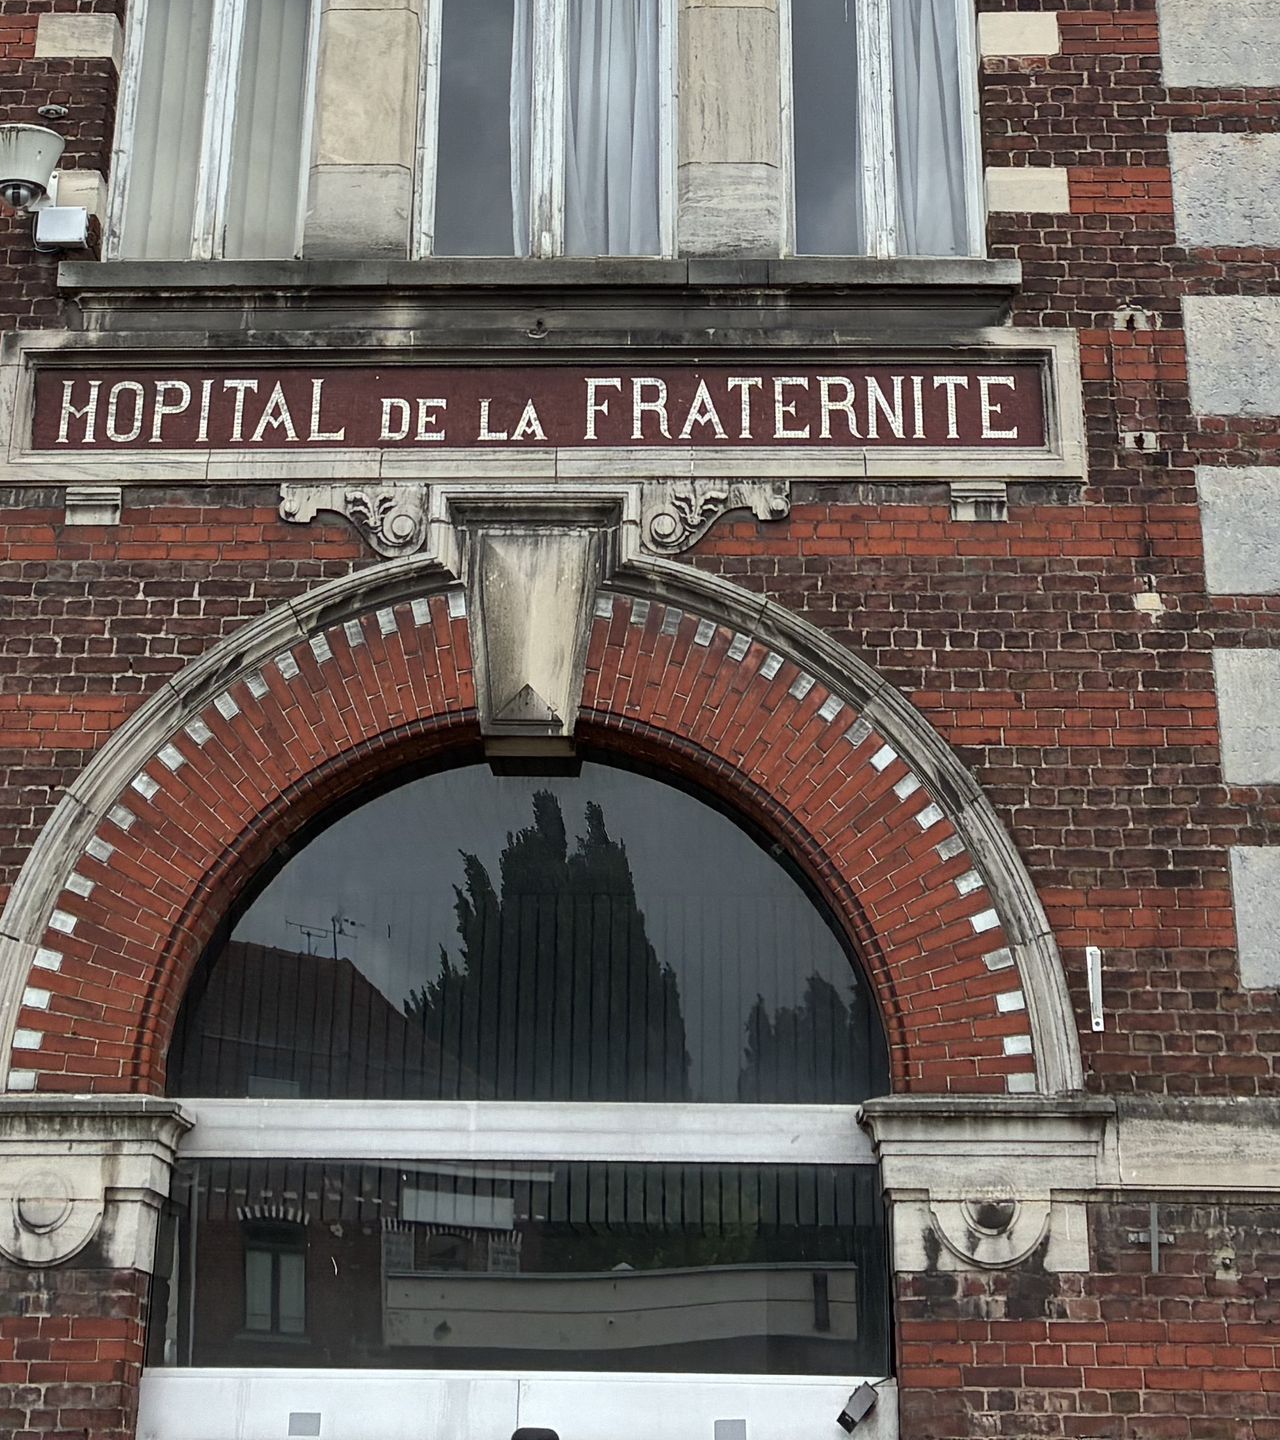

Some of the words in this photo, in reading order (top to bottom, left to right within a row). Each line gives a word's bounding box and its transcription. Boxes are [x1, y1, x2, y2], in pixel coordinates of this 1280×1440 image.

[55, 378, 345, 444] HOPITAL
[377, 397, 447, 441] DE
[477, 397, 548, 441] LA
[583, 375, 1018, 440] FRATERNITE
